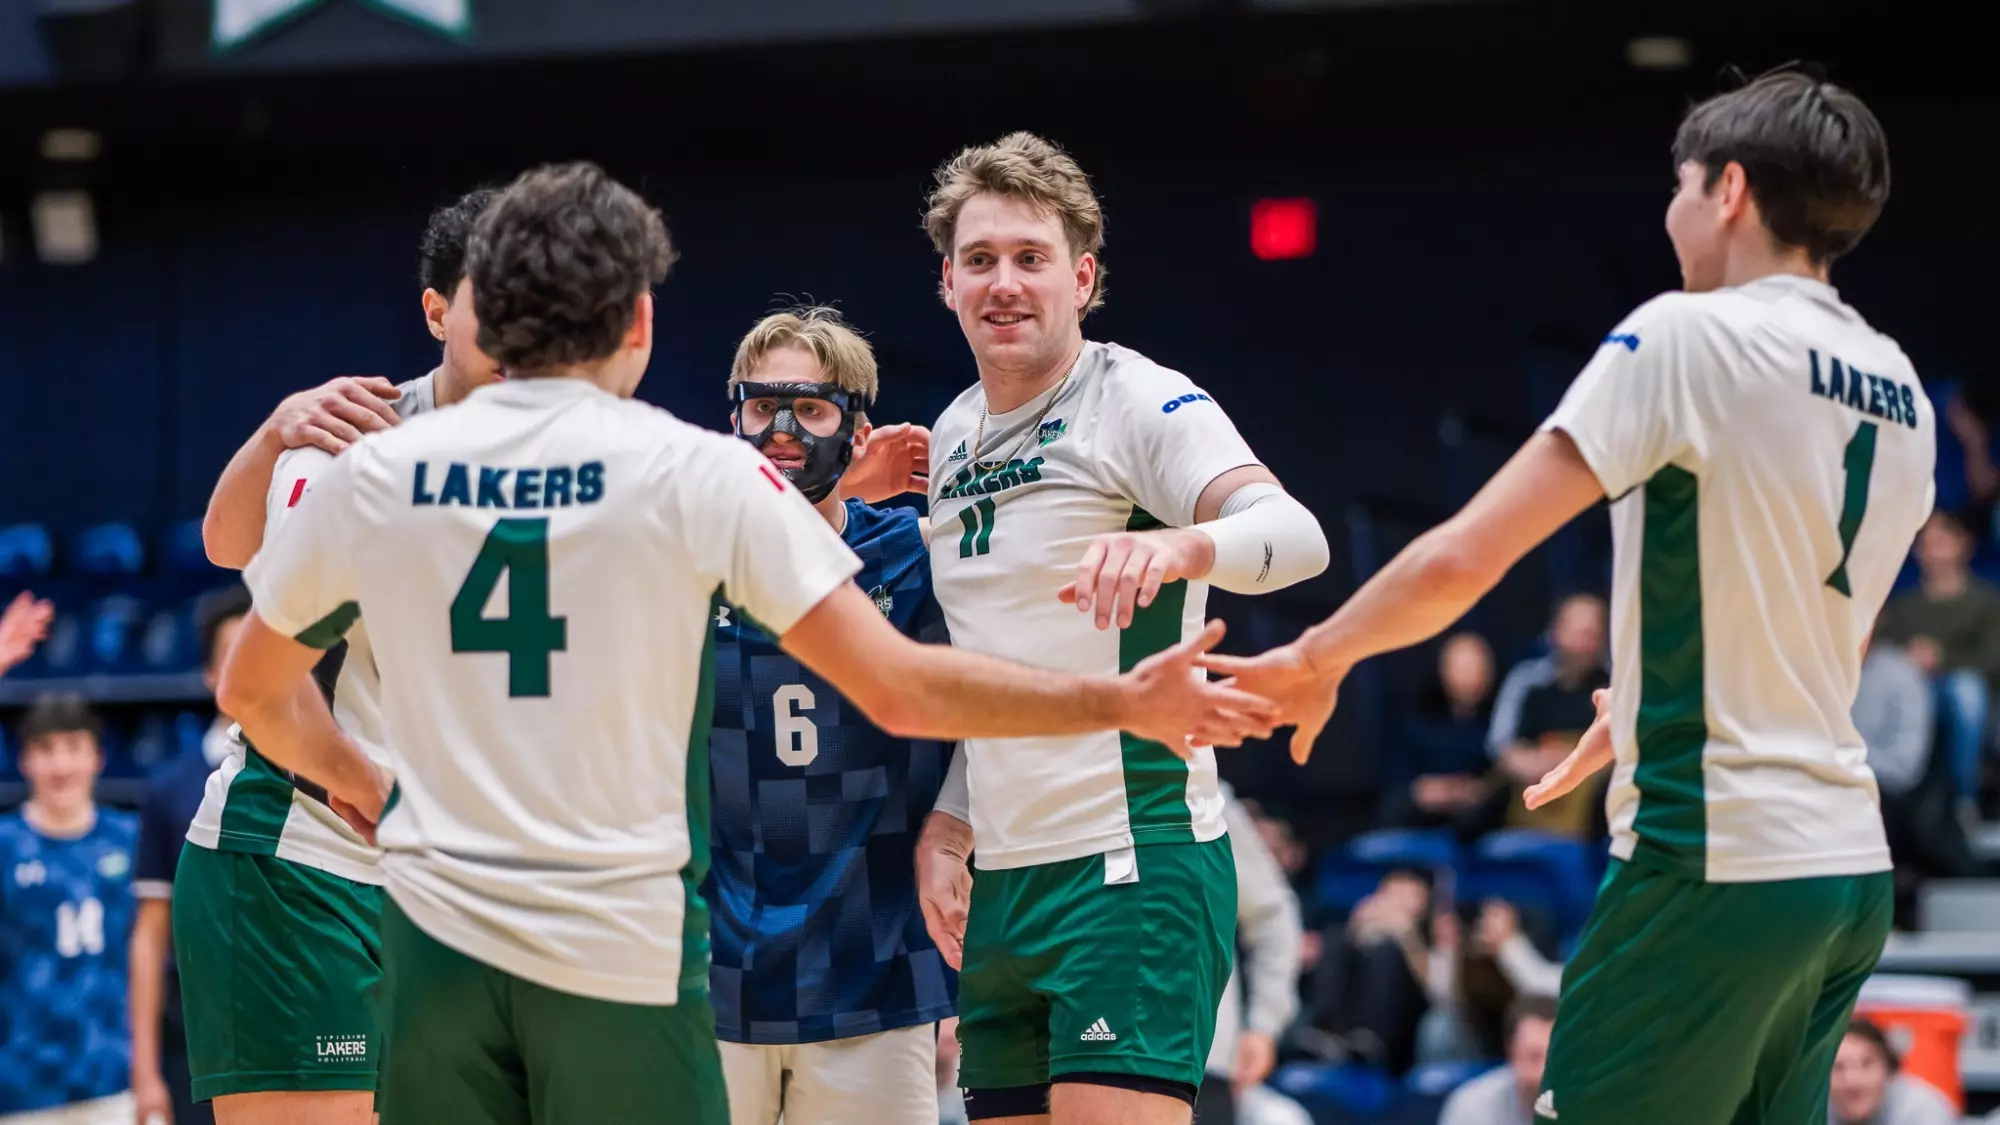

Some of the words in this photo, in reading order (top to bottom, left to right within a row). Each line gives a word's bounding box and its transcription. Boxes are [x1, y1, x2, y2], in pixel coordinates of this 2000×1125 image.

[1808, 348, 1917, 430] LAKERS
[412, 460, 607, 510] LAKERS
[948, 453, 968, 462] adidas
[959, 496, 997, 559] 11
[1824, 419, 1878, 598] 1
[449, 516, 568, 698] 4
[772, 684, 819, 767] 6
[316, 1041, 366, 1056] LAKERS
[1080, 1032, 1117, 1041] adidas
